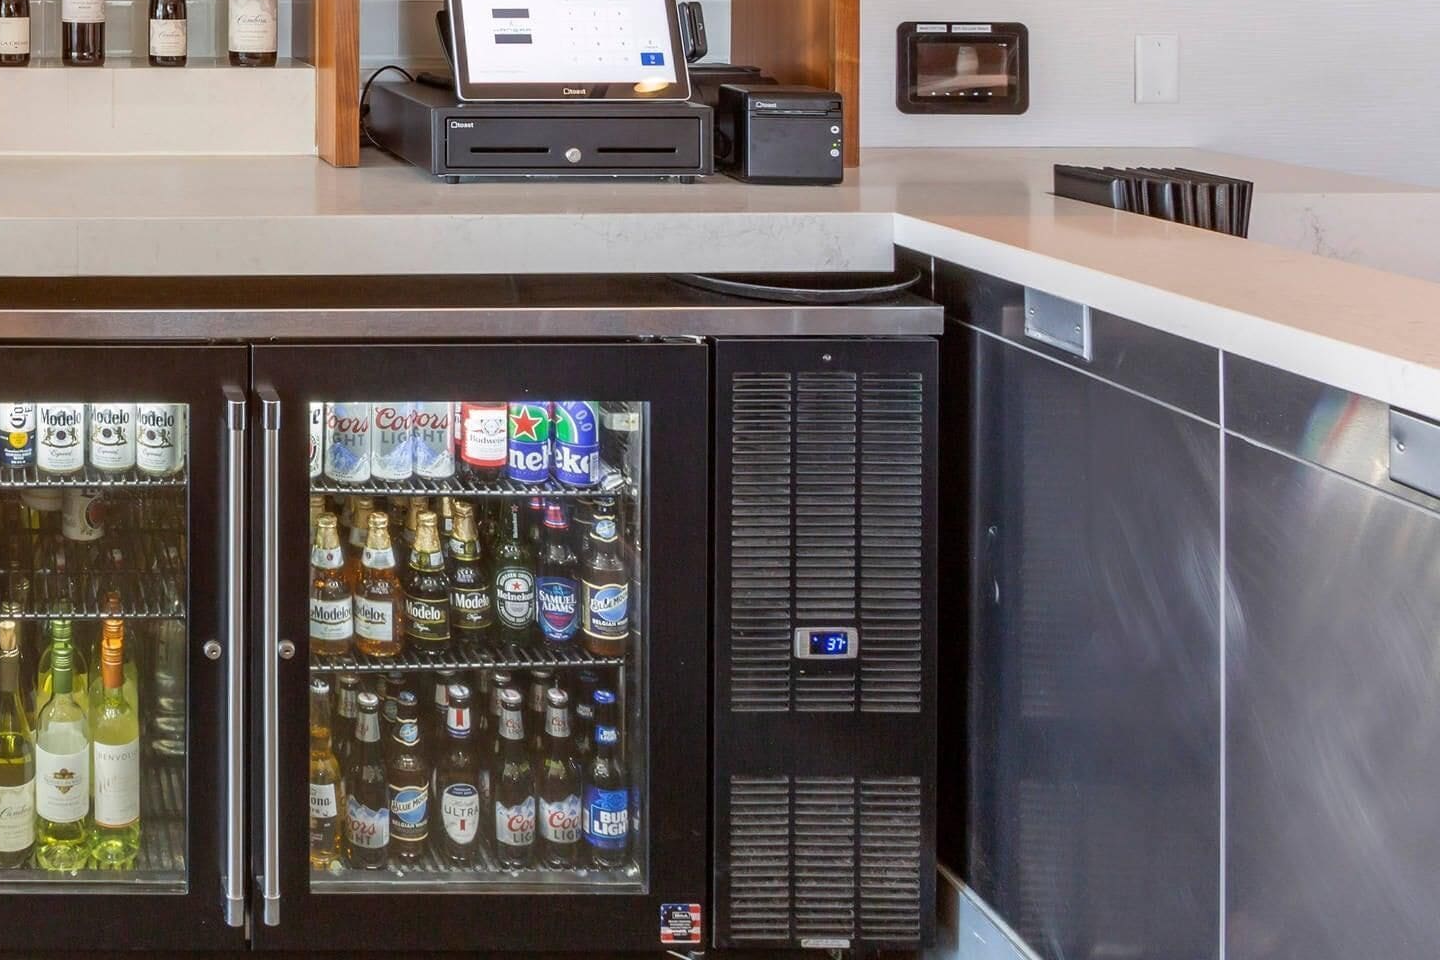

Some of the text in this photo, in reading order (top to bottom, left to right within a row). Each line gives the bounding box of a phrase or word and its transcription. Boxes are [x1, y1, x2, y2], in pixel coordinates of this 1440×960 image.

[41, 407, 82, 426] Modelo
[455, 592, 490, 609] Modelo
[539, 590, 577, 604] SAMUEL
[314, 605, 350, 621] Modelo
[541, 600, 575, 613] ADAMS
[827, 637, 843, 651] 37
[444, 805, 480, 817] ULTRA
